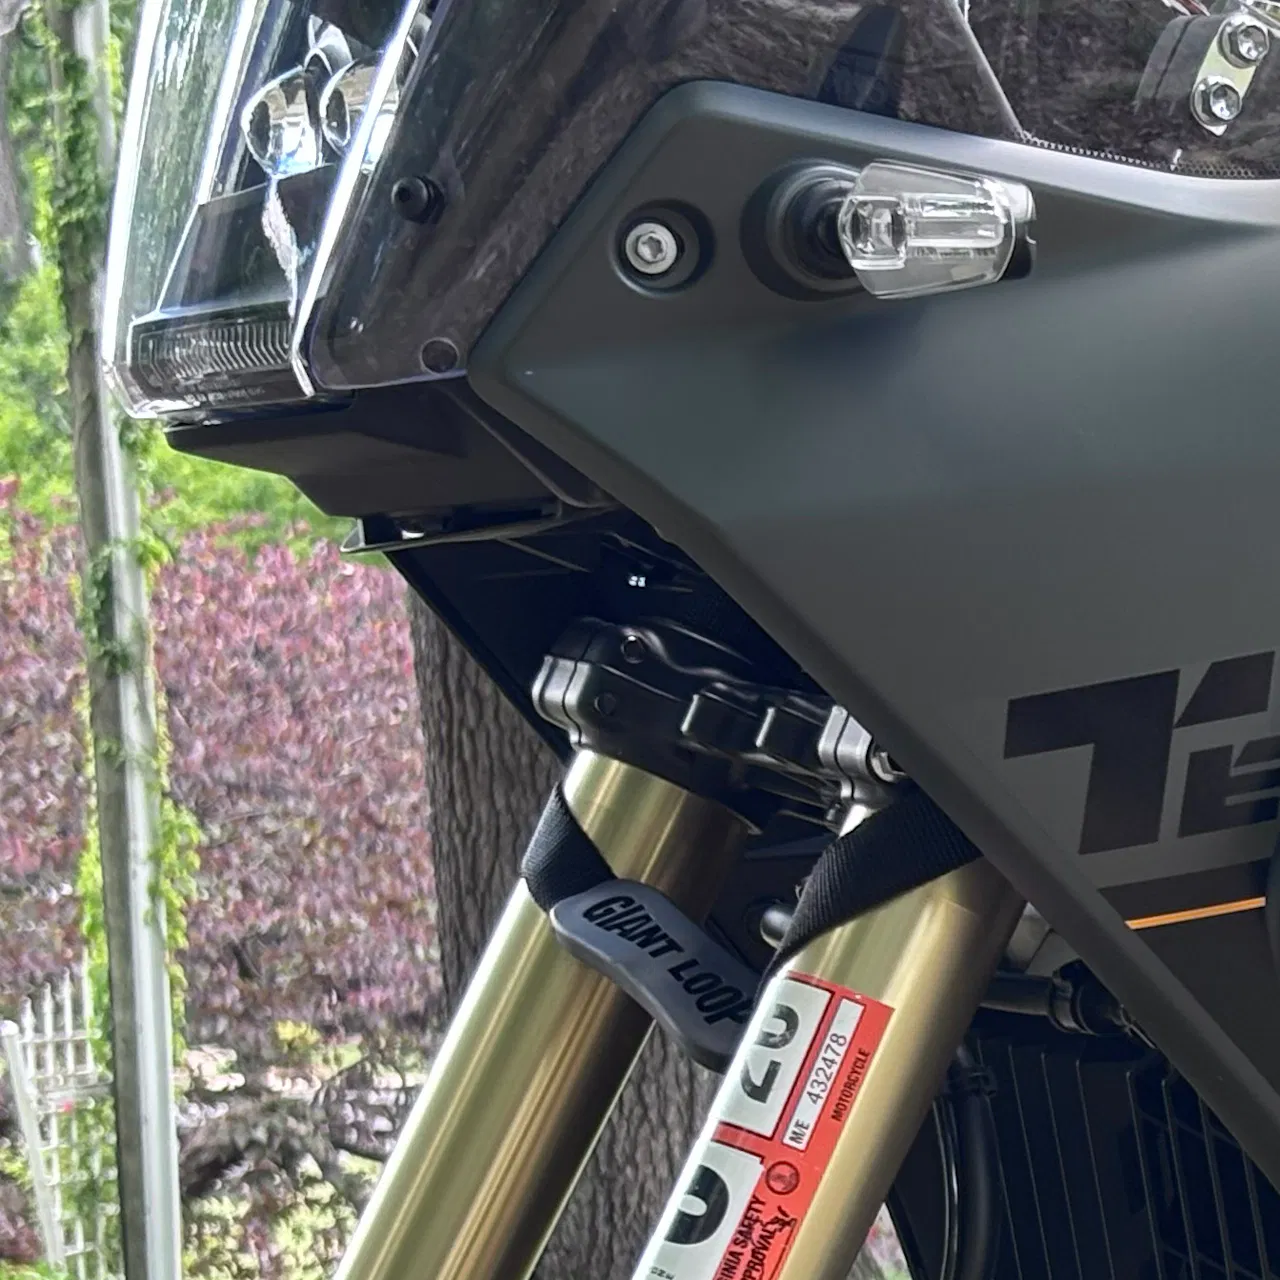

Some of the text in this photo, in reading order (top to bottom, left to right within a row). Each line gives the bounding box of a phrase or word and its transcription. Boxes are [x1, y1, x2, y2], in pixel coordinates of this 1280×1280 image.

[582, 894, 685, 959] GIANT
[788, 1033, 847, 1146] M/E 432478
[830, 1046, 871, 1122] MOTORCYCLE
[734, 1194, 767, 1248] SAFETY
